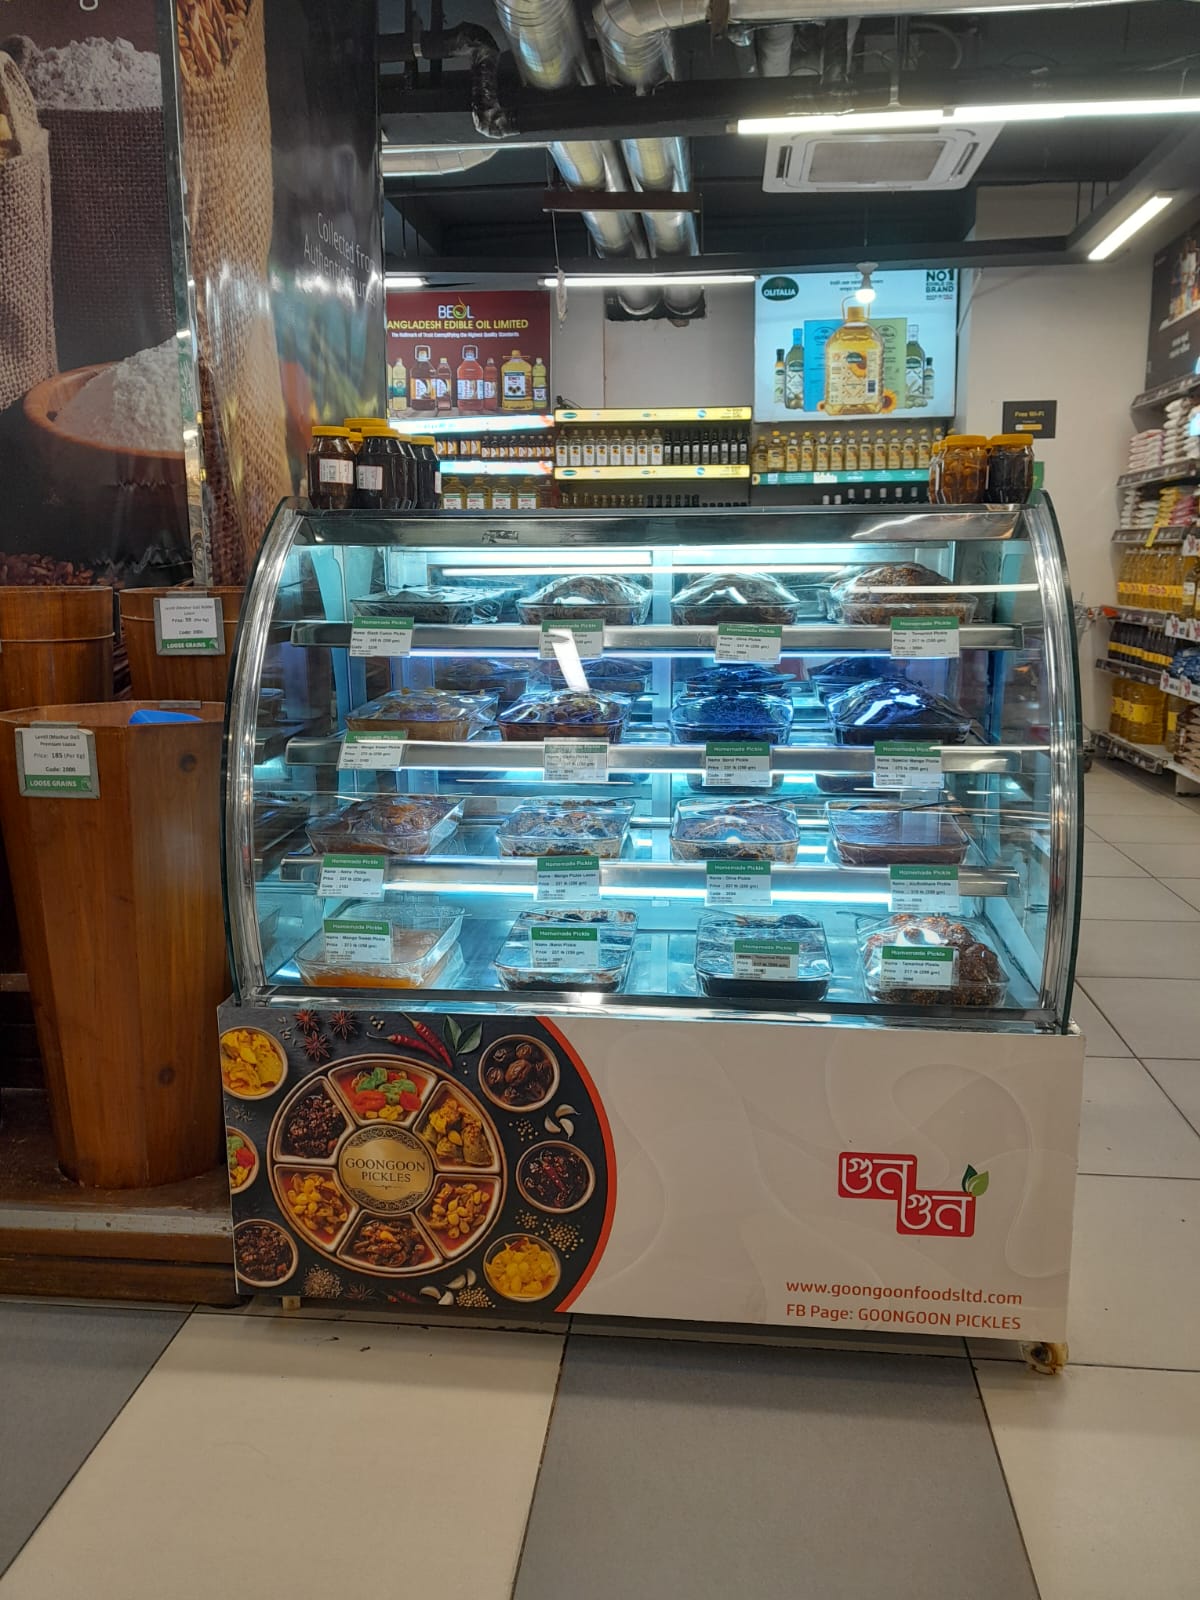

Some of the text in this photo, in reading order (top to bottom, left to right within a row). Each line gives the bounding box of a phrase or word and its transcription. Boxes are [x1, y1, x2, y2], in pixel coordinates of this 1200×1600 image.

[317, 212, 355, 264] Collected
[763, 288, 797, 297] OLITALIA
[925, 285, 955, 293] BRAND
[438, 304, 475, 319] BEOL
[387, 319, 529, 329] ANGLADESH EDIBLE OIL LIMITED
[345, 1157, 426, 1173] GOONGOON
[361, 1171, 411, 1183] PICKLES
[786, 1281, 1023, 1305] www.goongoonfoodsltd.com
[786, 1303, 1022, 1330] FB Page: GOONGOON PICKLES
